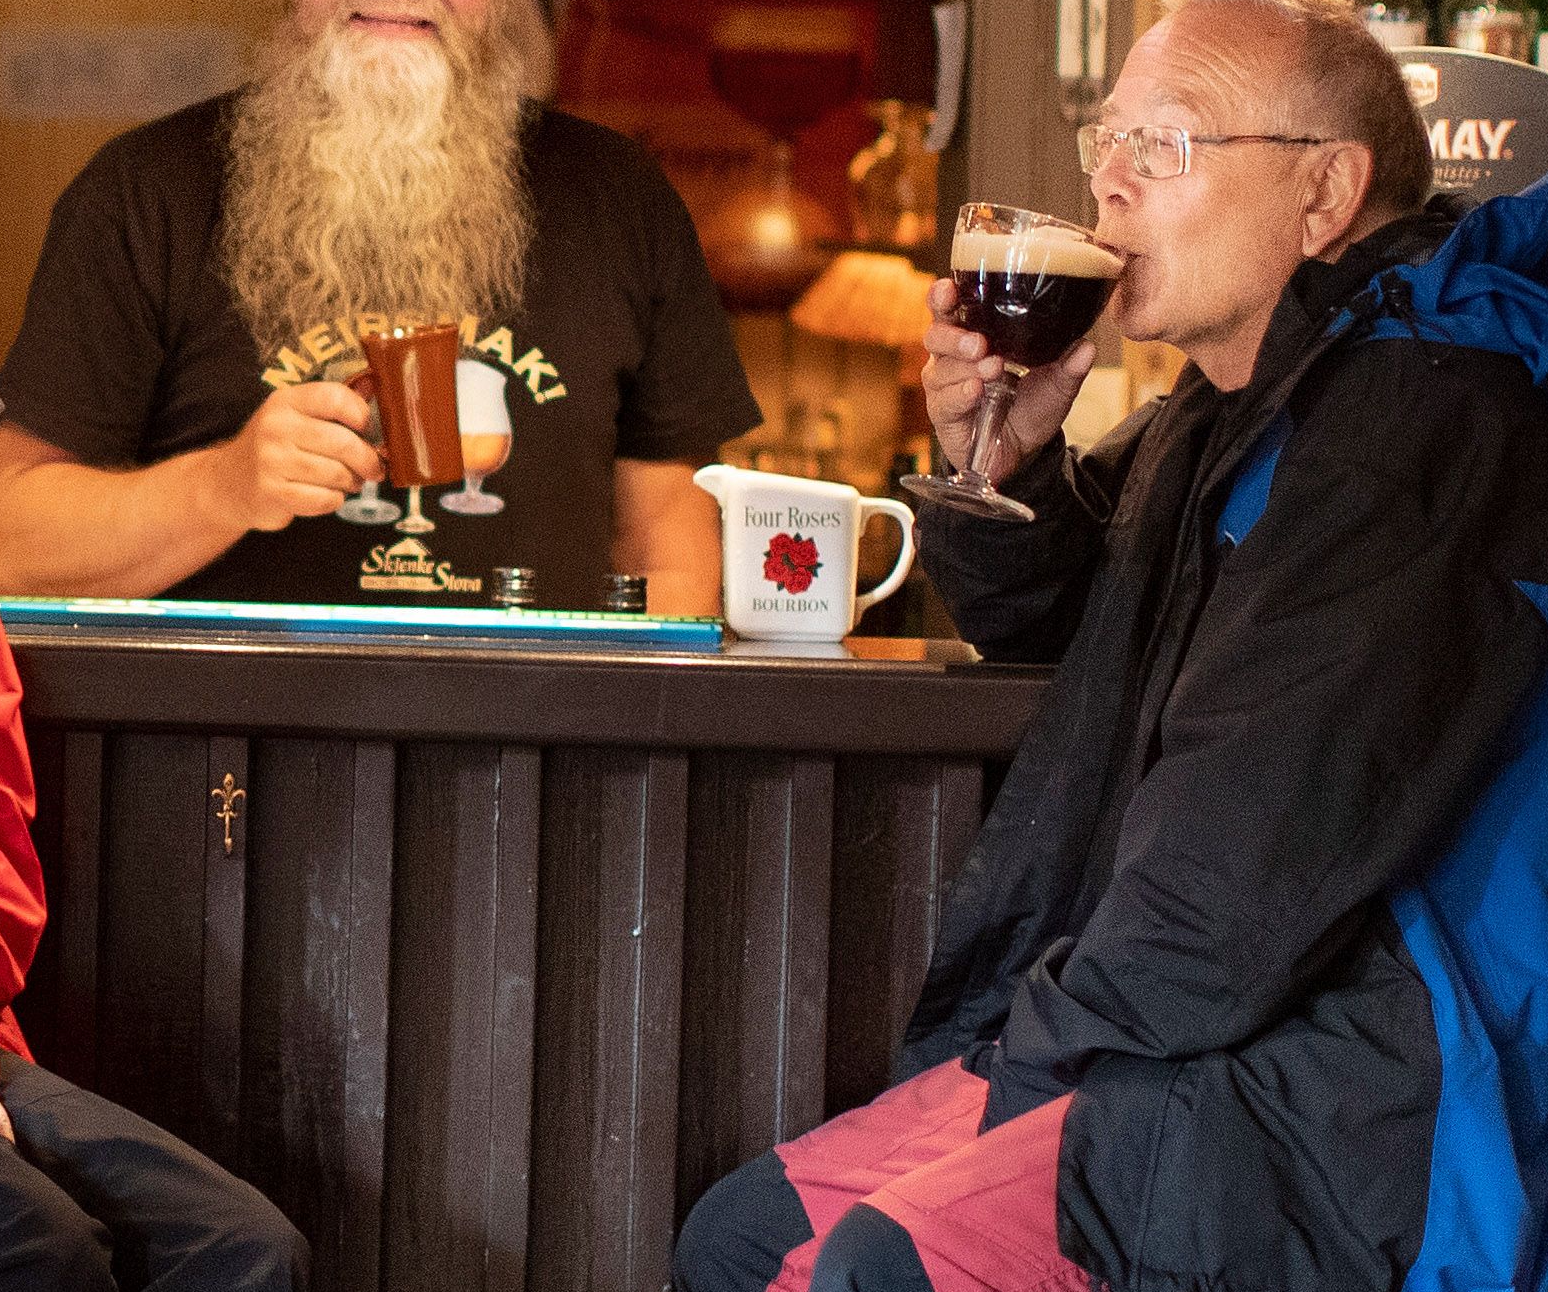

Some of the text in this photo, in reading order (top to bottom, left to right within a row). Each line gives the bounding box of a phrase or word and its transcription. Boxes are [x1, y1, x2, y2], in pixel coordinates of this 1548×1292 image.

[1429, 118, 1518, 160] MAY
[744, 506, 841, 529] Four Roses
[752, 598, 830, 612] BOURBON
